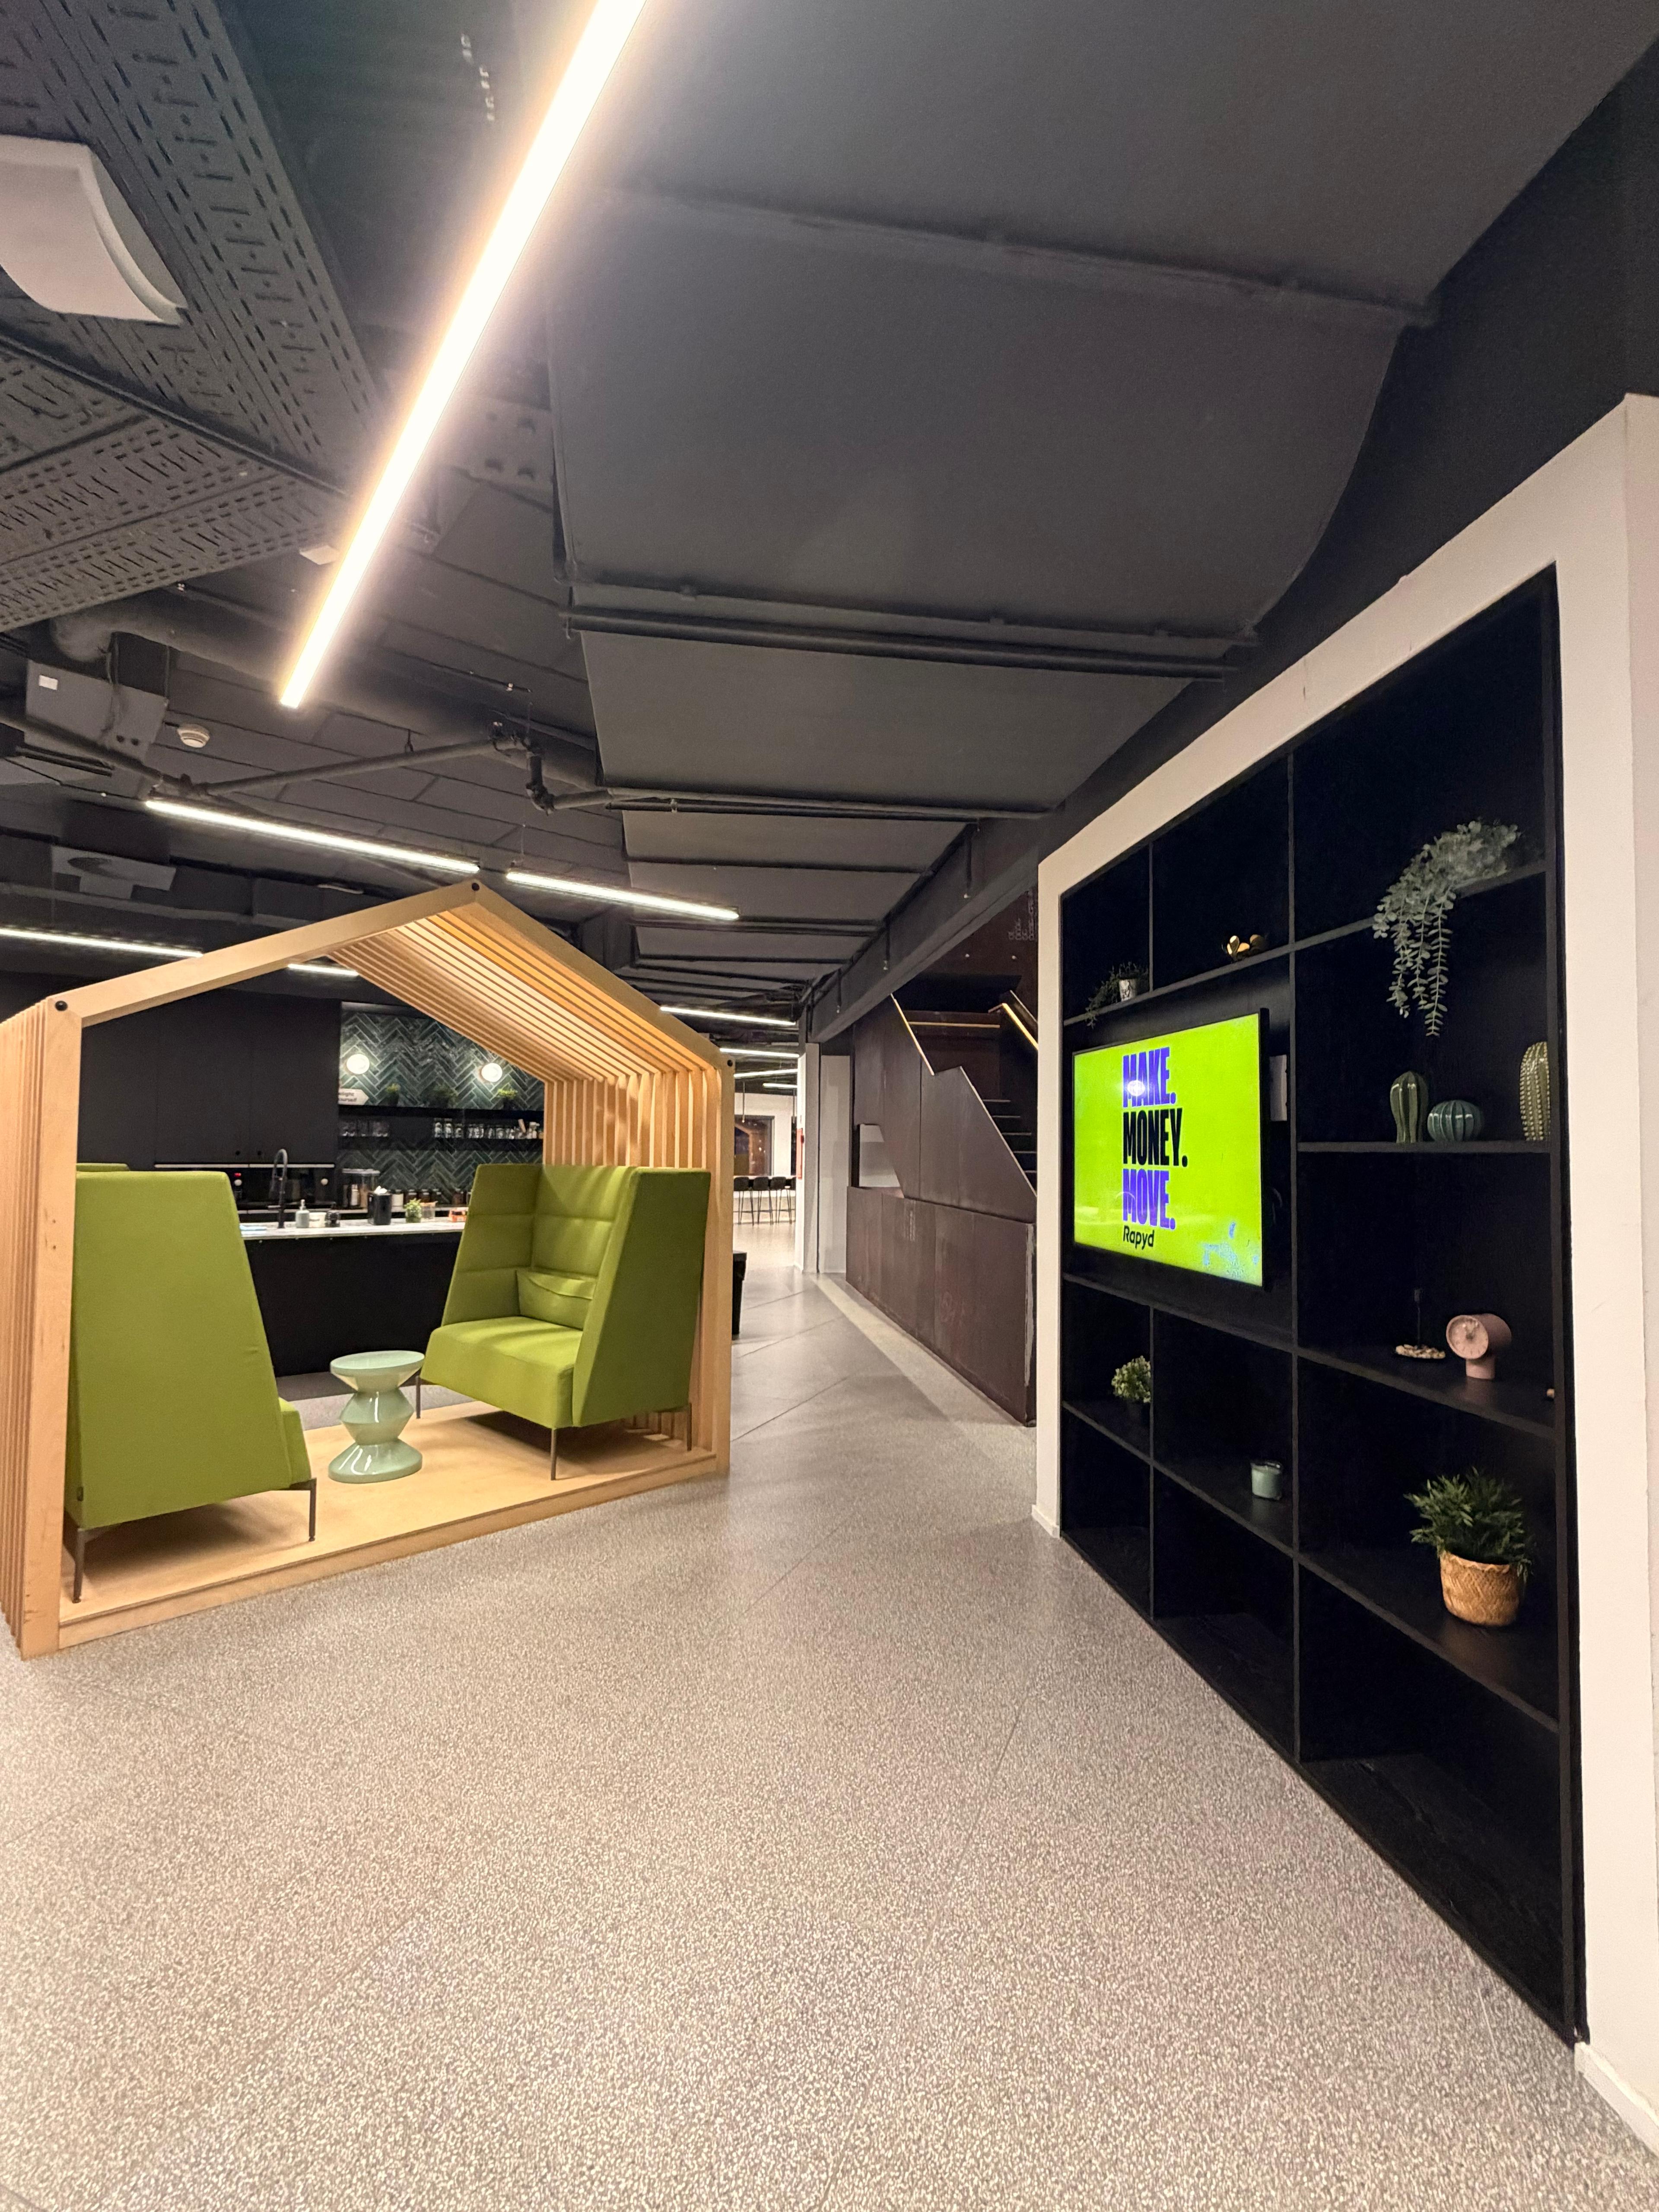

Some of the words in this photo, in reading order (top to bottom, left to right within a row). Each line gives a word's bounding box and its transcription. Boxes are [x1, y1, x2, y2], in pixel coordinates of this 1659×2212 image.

[1123, 1047, 1176, 1107] MAKE.
[1123, 1108, 1188, 1167] MONEY.
[1123, 1168, 1176, 1230] MOVE.
[1123, 1226, 1154, 1249] Rapyd
